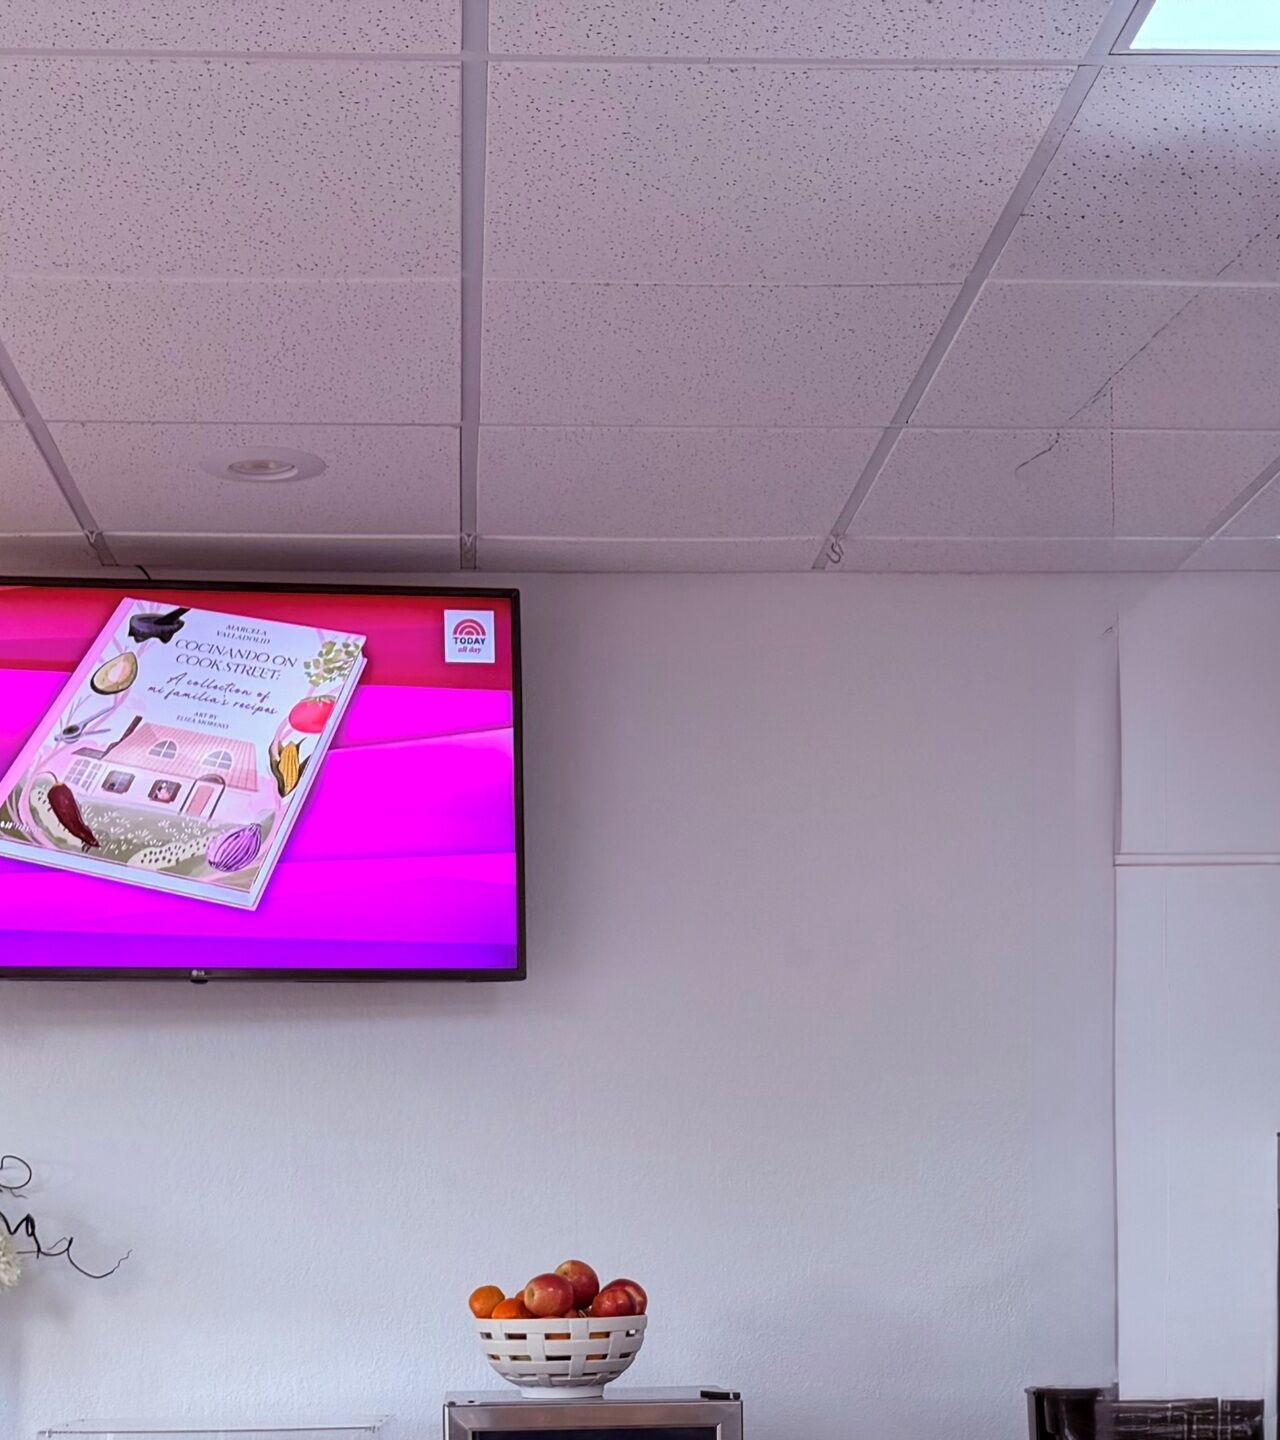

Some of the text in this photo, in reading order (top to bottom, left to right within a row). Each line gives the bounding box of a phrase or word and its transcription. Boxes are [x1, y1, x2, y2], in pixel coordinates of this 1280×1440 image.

[226, 624, 267, 636] MARCELA
[216, 630, 271, 644] VALLADOLID
[453, 637, 486, 645] TODAY
[175, 639, 298, 668] COCINANDO ON
[469, 646, 481, 655] day
[176, 654, 281, 680] COOK STREET:
[147, 685, 165, 693] mi
[166, 672, 271, 703] A collection of
